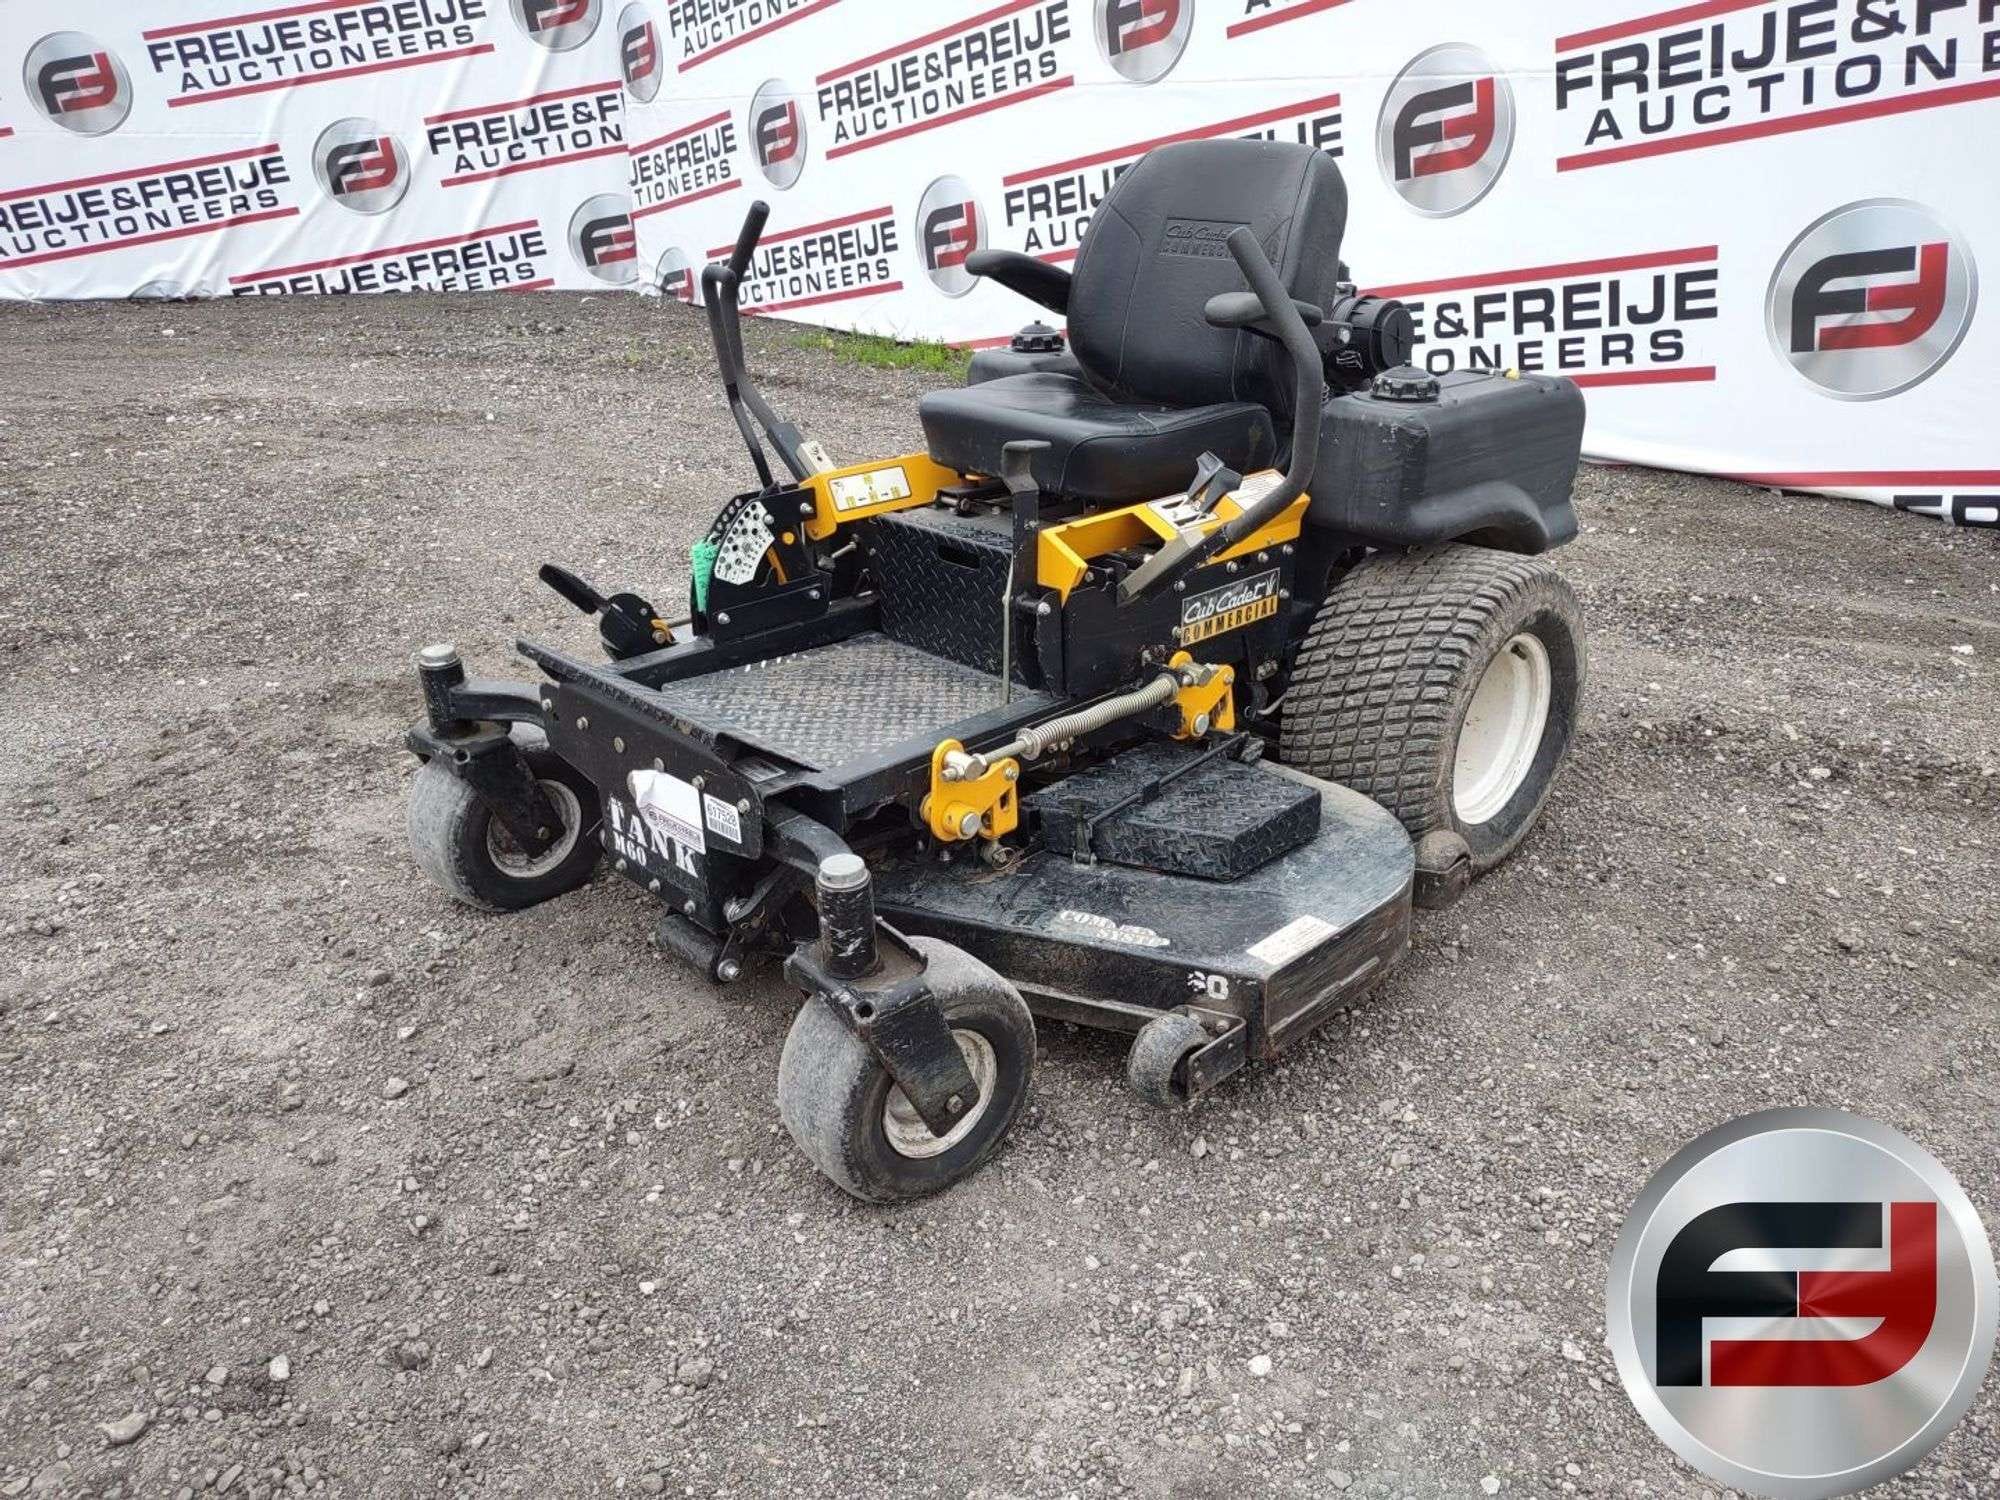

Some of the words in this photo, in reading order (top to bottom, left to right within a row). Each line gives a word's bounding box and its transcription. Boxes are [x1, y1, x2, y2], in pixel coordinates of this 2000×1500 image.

[181, 24, 474, 93] AUCTIONEERS
[817, 0, 1071, 121] FREIJE&FREIJE
[427, 92, 626, 155] FREIJE&F
[834, 49, 1058, 144] AUCTIONEERS
[738, 258, 890, 306] UCTIONEERS
[1182, 599, 1276, 645] COMMERCIAL
[1184, 597, 1215, 624] Cub
[1217, 582, 1266, 612] Cadet
